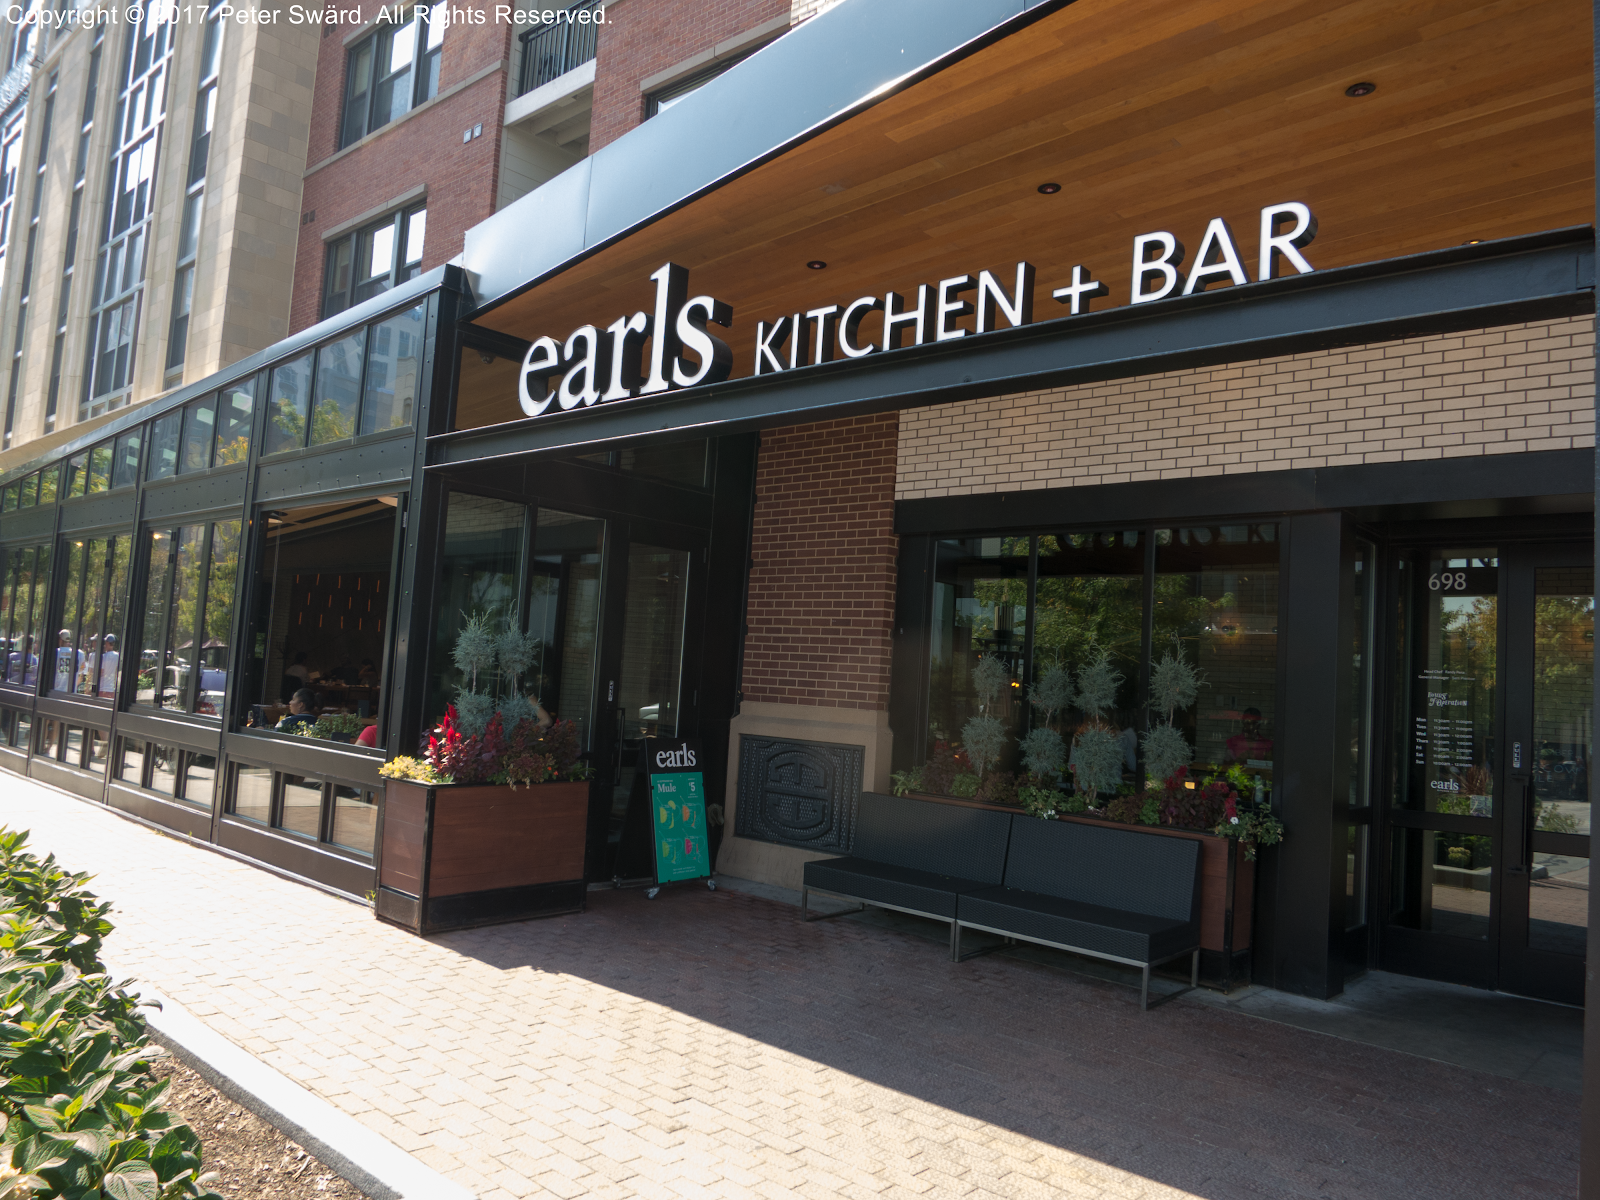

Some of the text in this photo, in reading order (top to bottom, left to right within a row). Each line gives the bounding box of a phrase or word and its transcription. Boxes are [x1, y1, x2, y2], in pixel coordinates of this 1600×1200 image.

[519, 262, 732, 418] earls
[754, 261, 1034, 377] KITCHEN
[1131, 201, 1318, 306] BAR
[1428, 572, 1467, 591] 698
[656, 742, 697, 768] earls
[657, 783, 676, 793] Mule
[1430, 779, 1459, 790] earls
